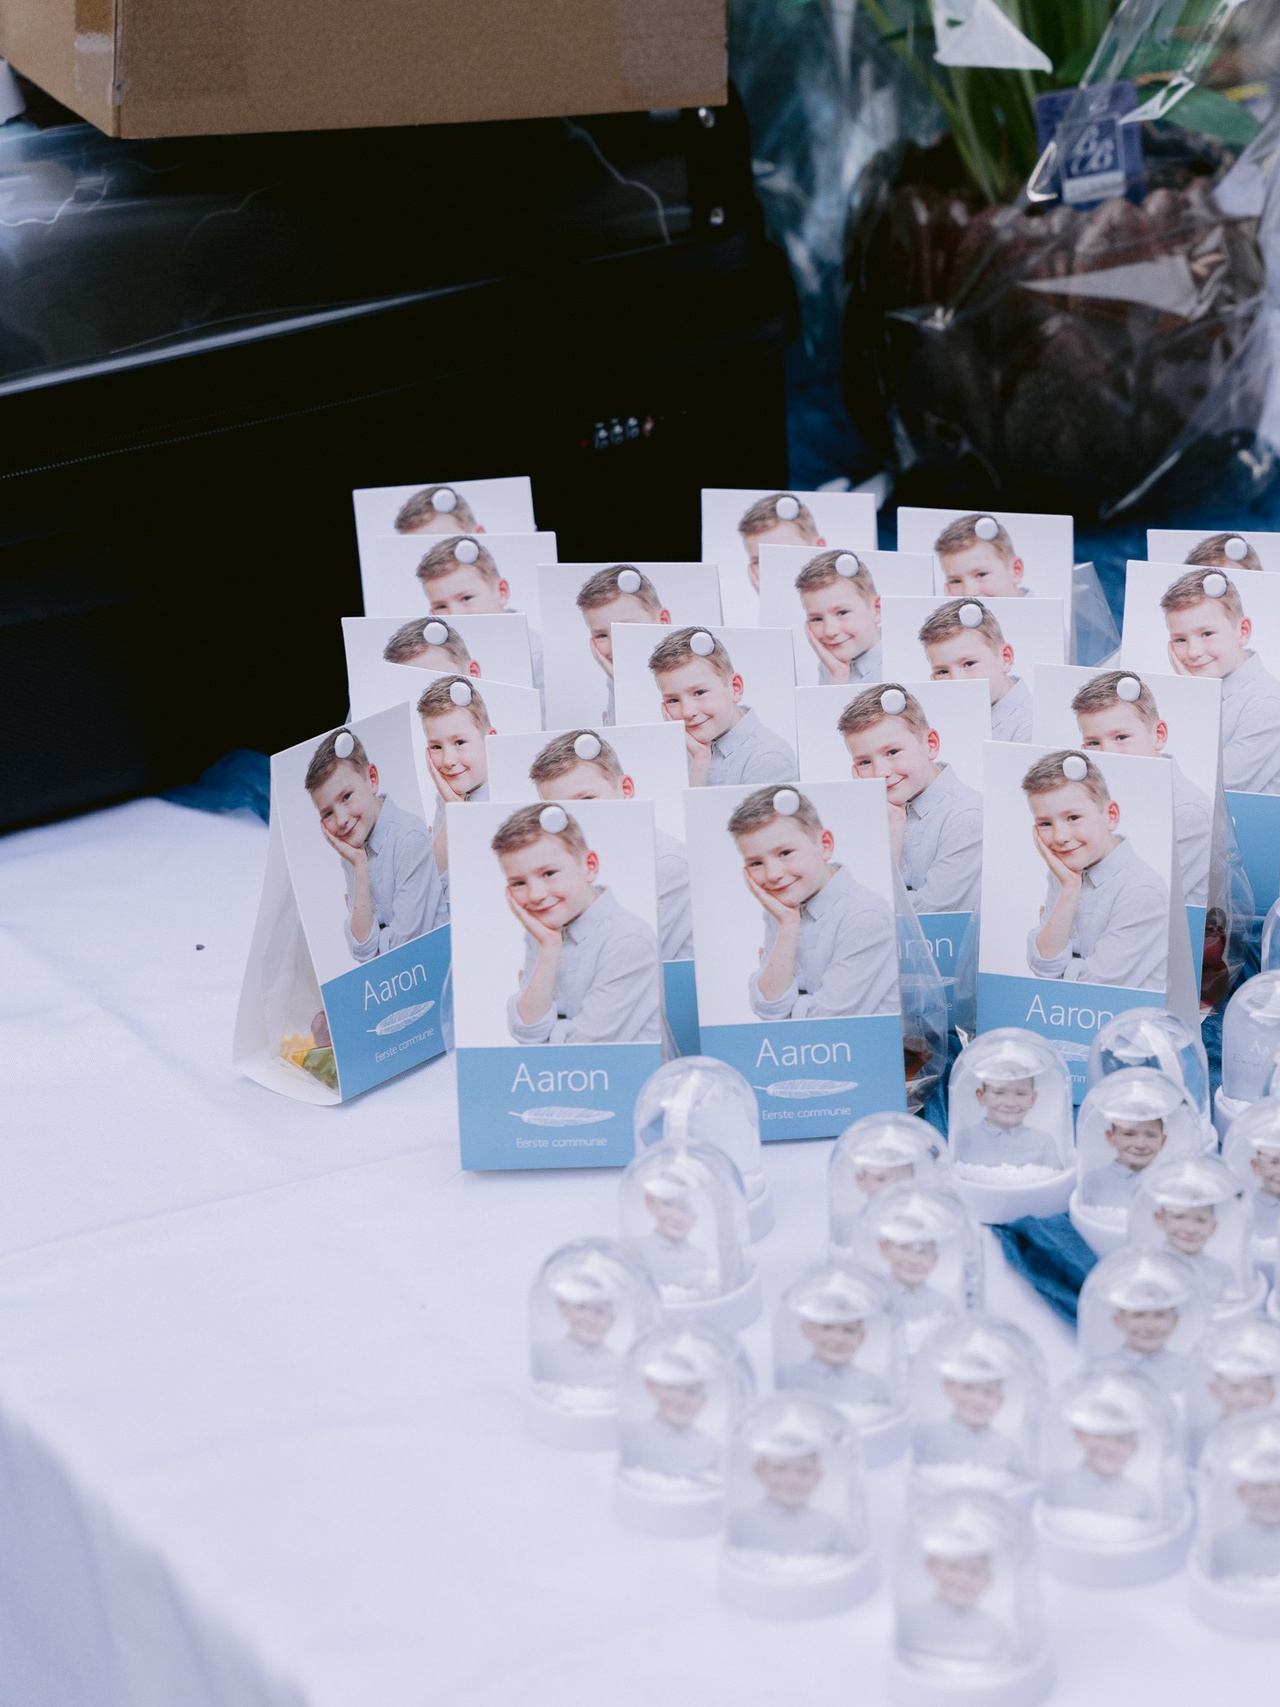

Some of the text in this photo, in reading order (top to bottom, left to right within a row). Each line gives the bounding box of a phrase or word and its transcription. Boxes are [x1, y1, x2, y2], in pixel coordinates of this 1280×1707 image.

[898, 938, 953, 960] ron
[364, 964, 427, 1011] Aaron
[1025, 994, 1114, 1030] Aaron
[375, 1027, 435, 1063] Eerste communie
[755, 1038, 851, 1068] Aaron
[510, 1062, 609, 1093] Aaron
[762, 1106, 852, 1121] Eerste communie
[515, 1138, 607, 1149] Eerste communie
